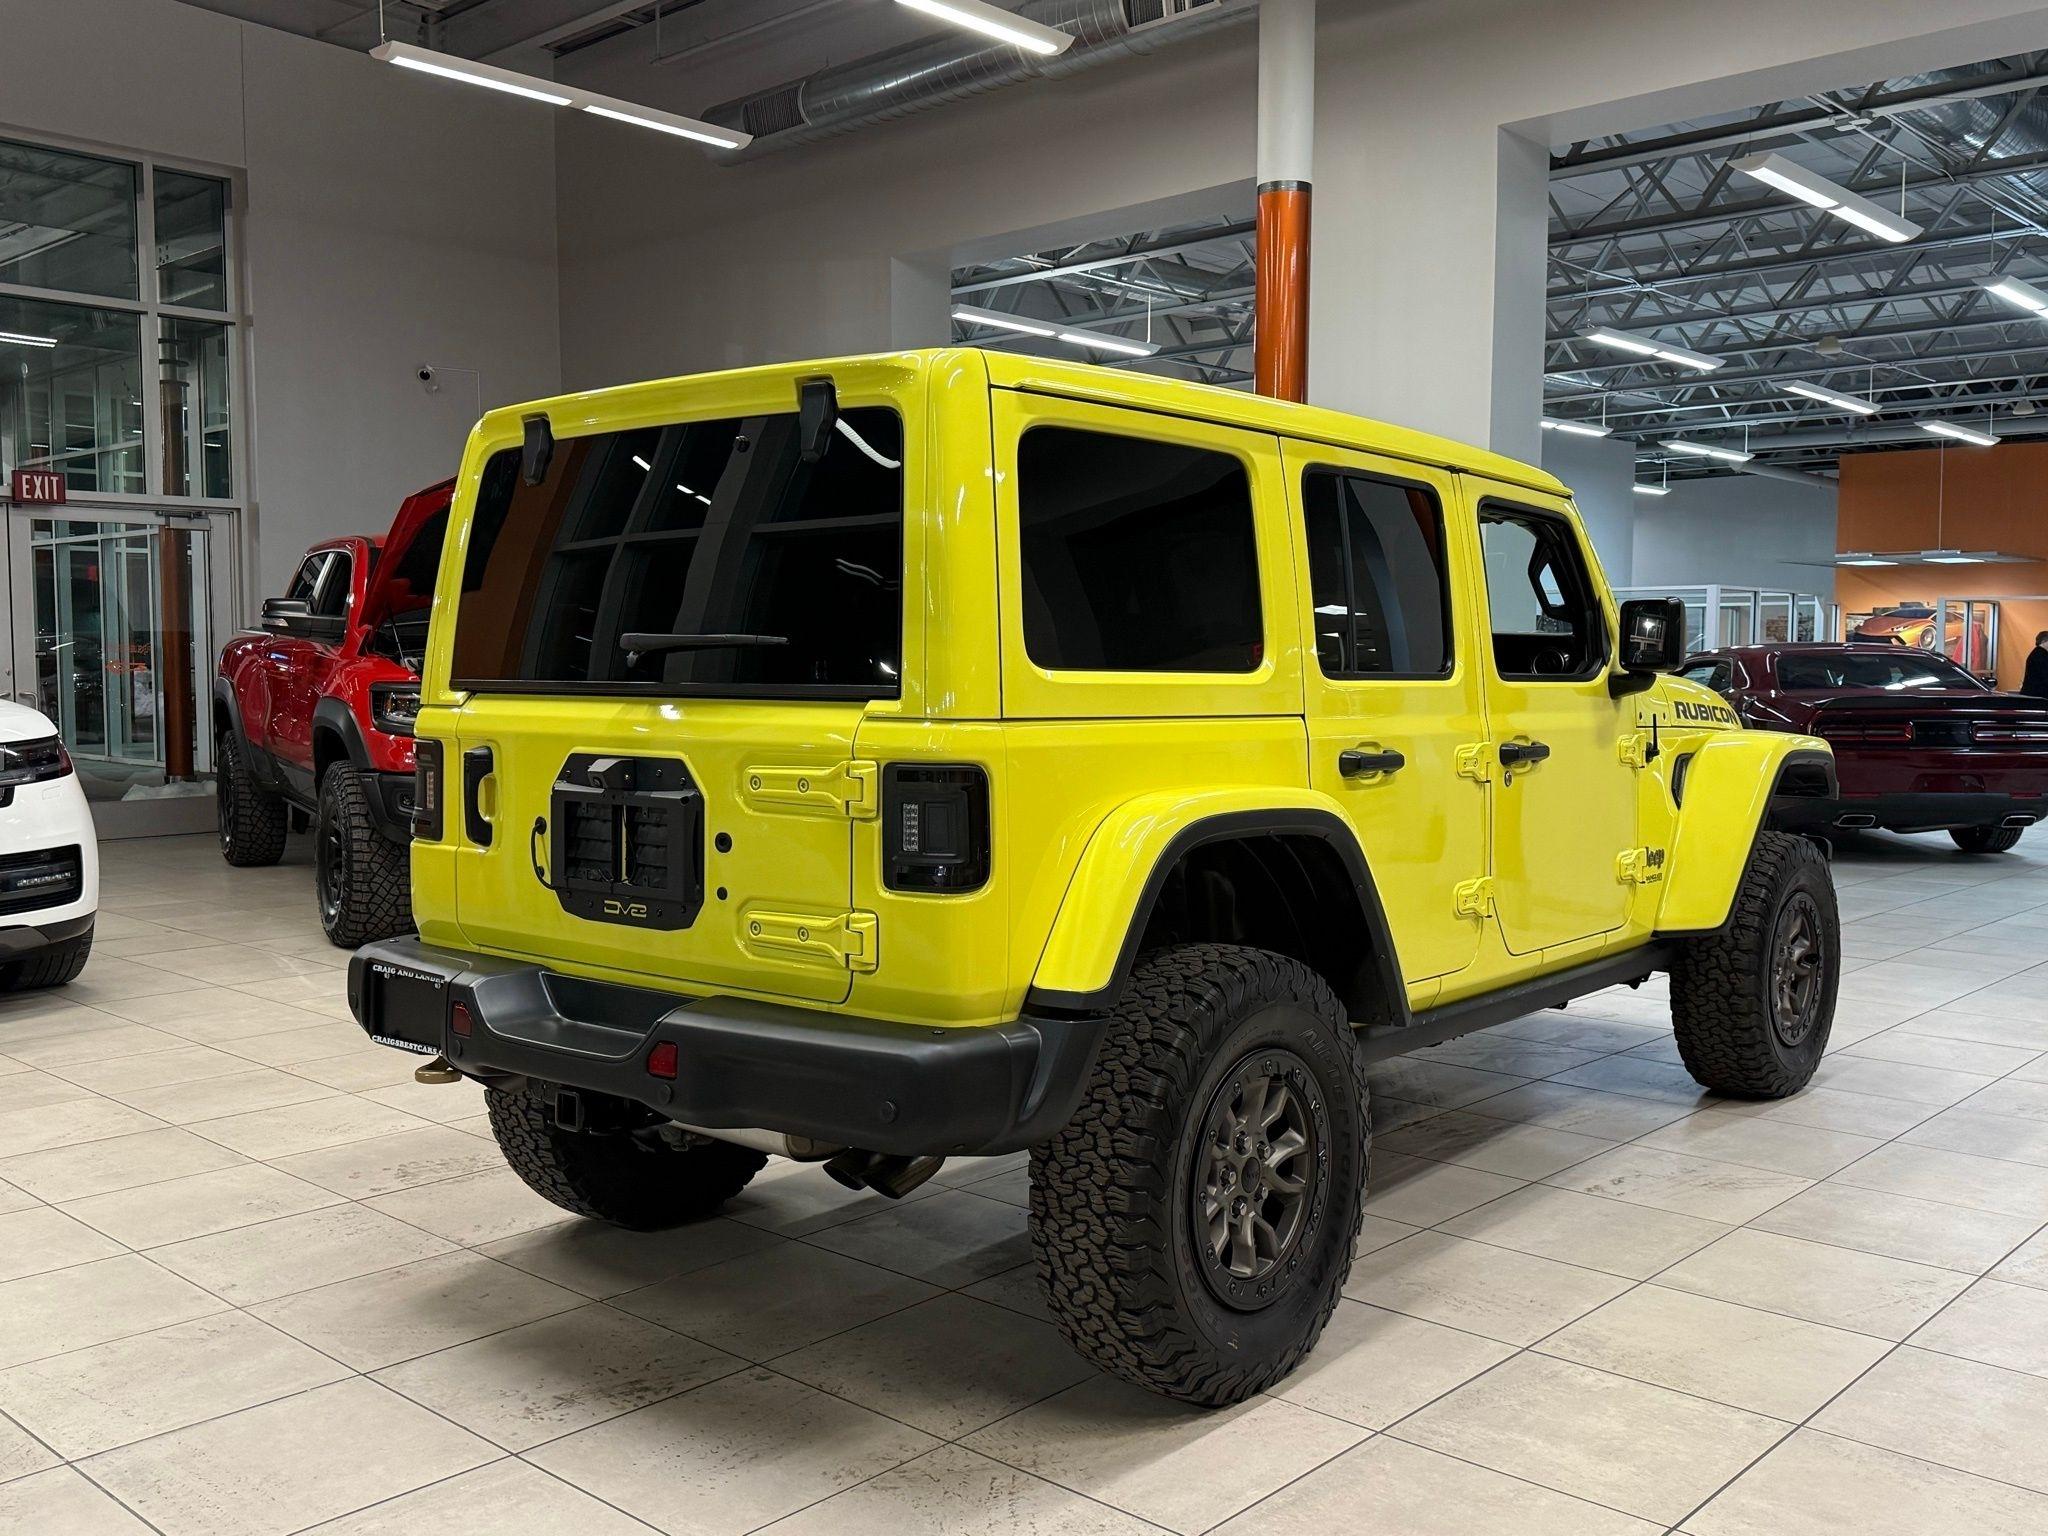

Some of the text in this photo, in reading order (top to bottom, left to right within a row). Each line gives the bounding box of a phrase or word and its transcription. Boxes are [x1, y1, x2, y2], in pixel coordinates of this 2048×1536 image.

[21, 474, 59, 500] EXIT
[1674, 700, 1739, 726] RUBICON
[372, 964, 396, 974] CRAIG
[397, 969, 414, 978] AND
